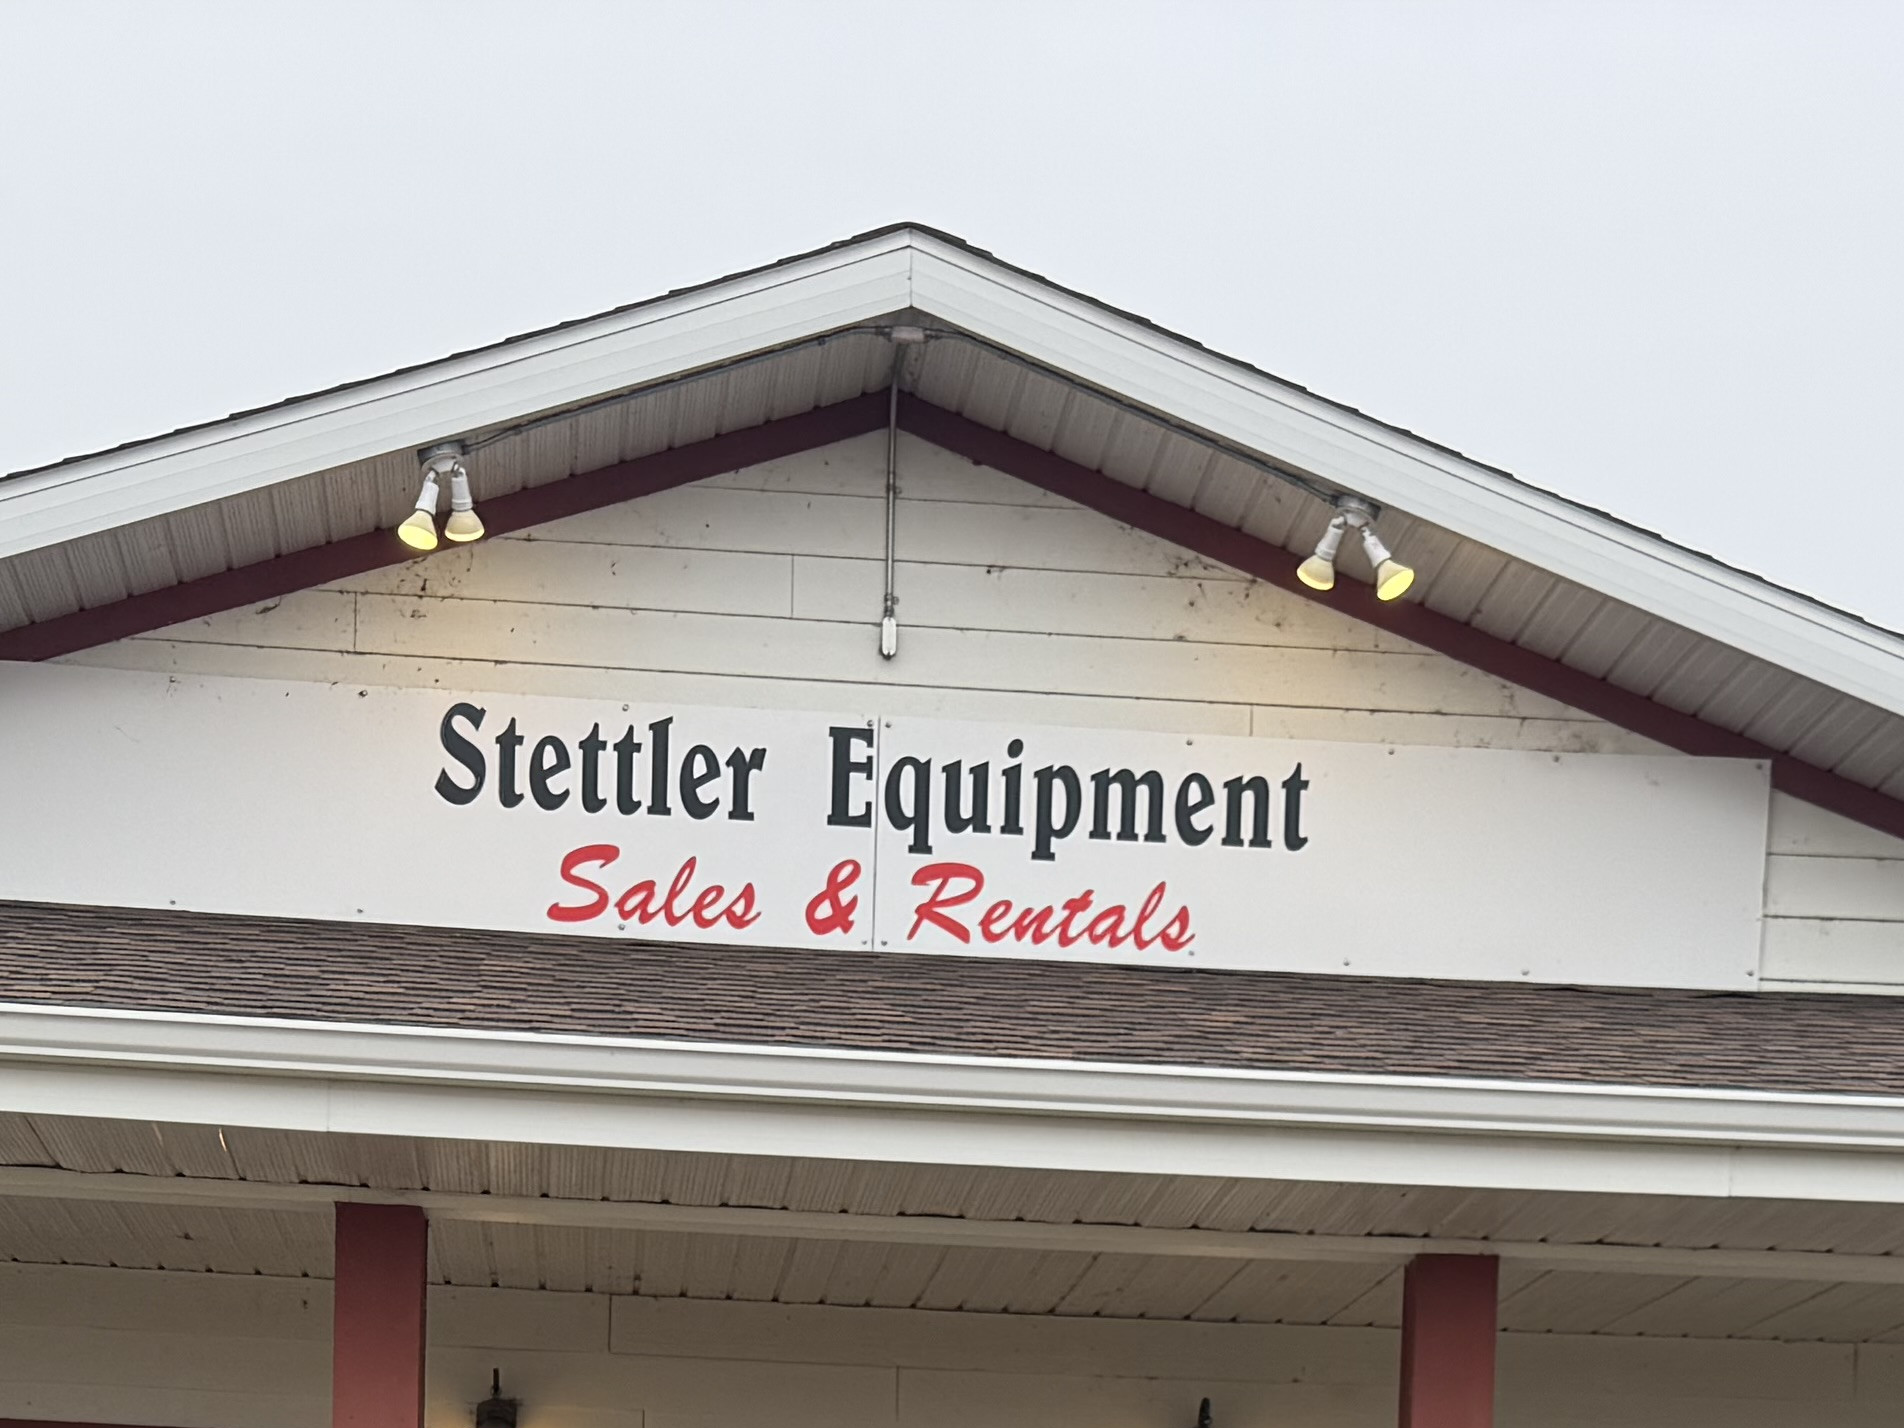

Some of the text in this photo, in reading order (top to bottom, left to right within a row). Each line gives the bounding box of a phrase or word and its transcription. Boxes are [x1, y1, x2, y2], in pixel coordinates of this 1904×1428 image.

[433, 701, 1311, 863] Stettler Equipment
[546, 843, 1196, 952] Sales & Rentals
